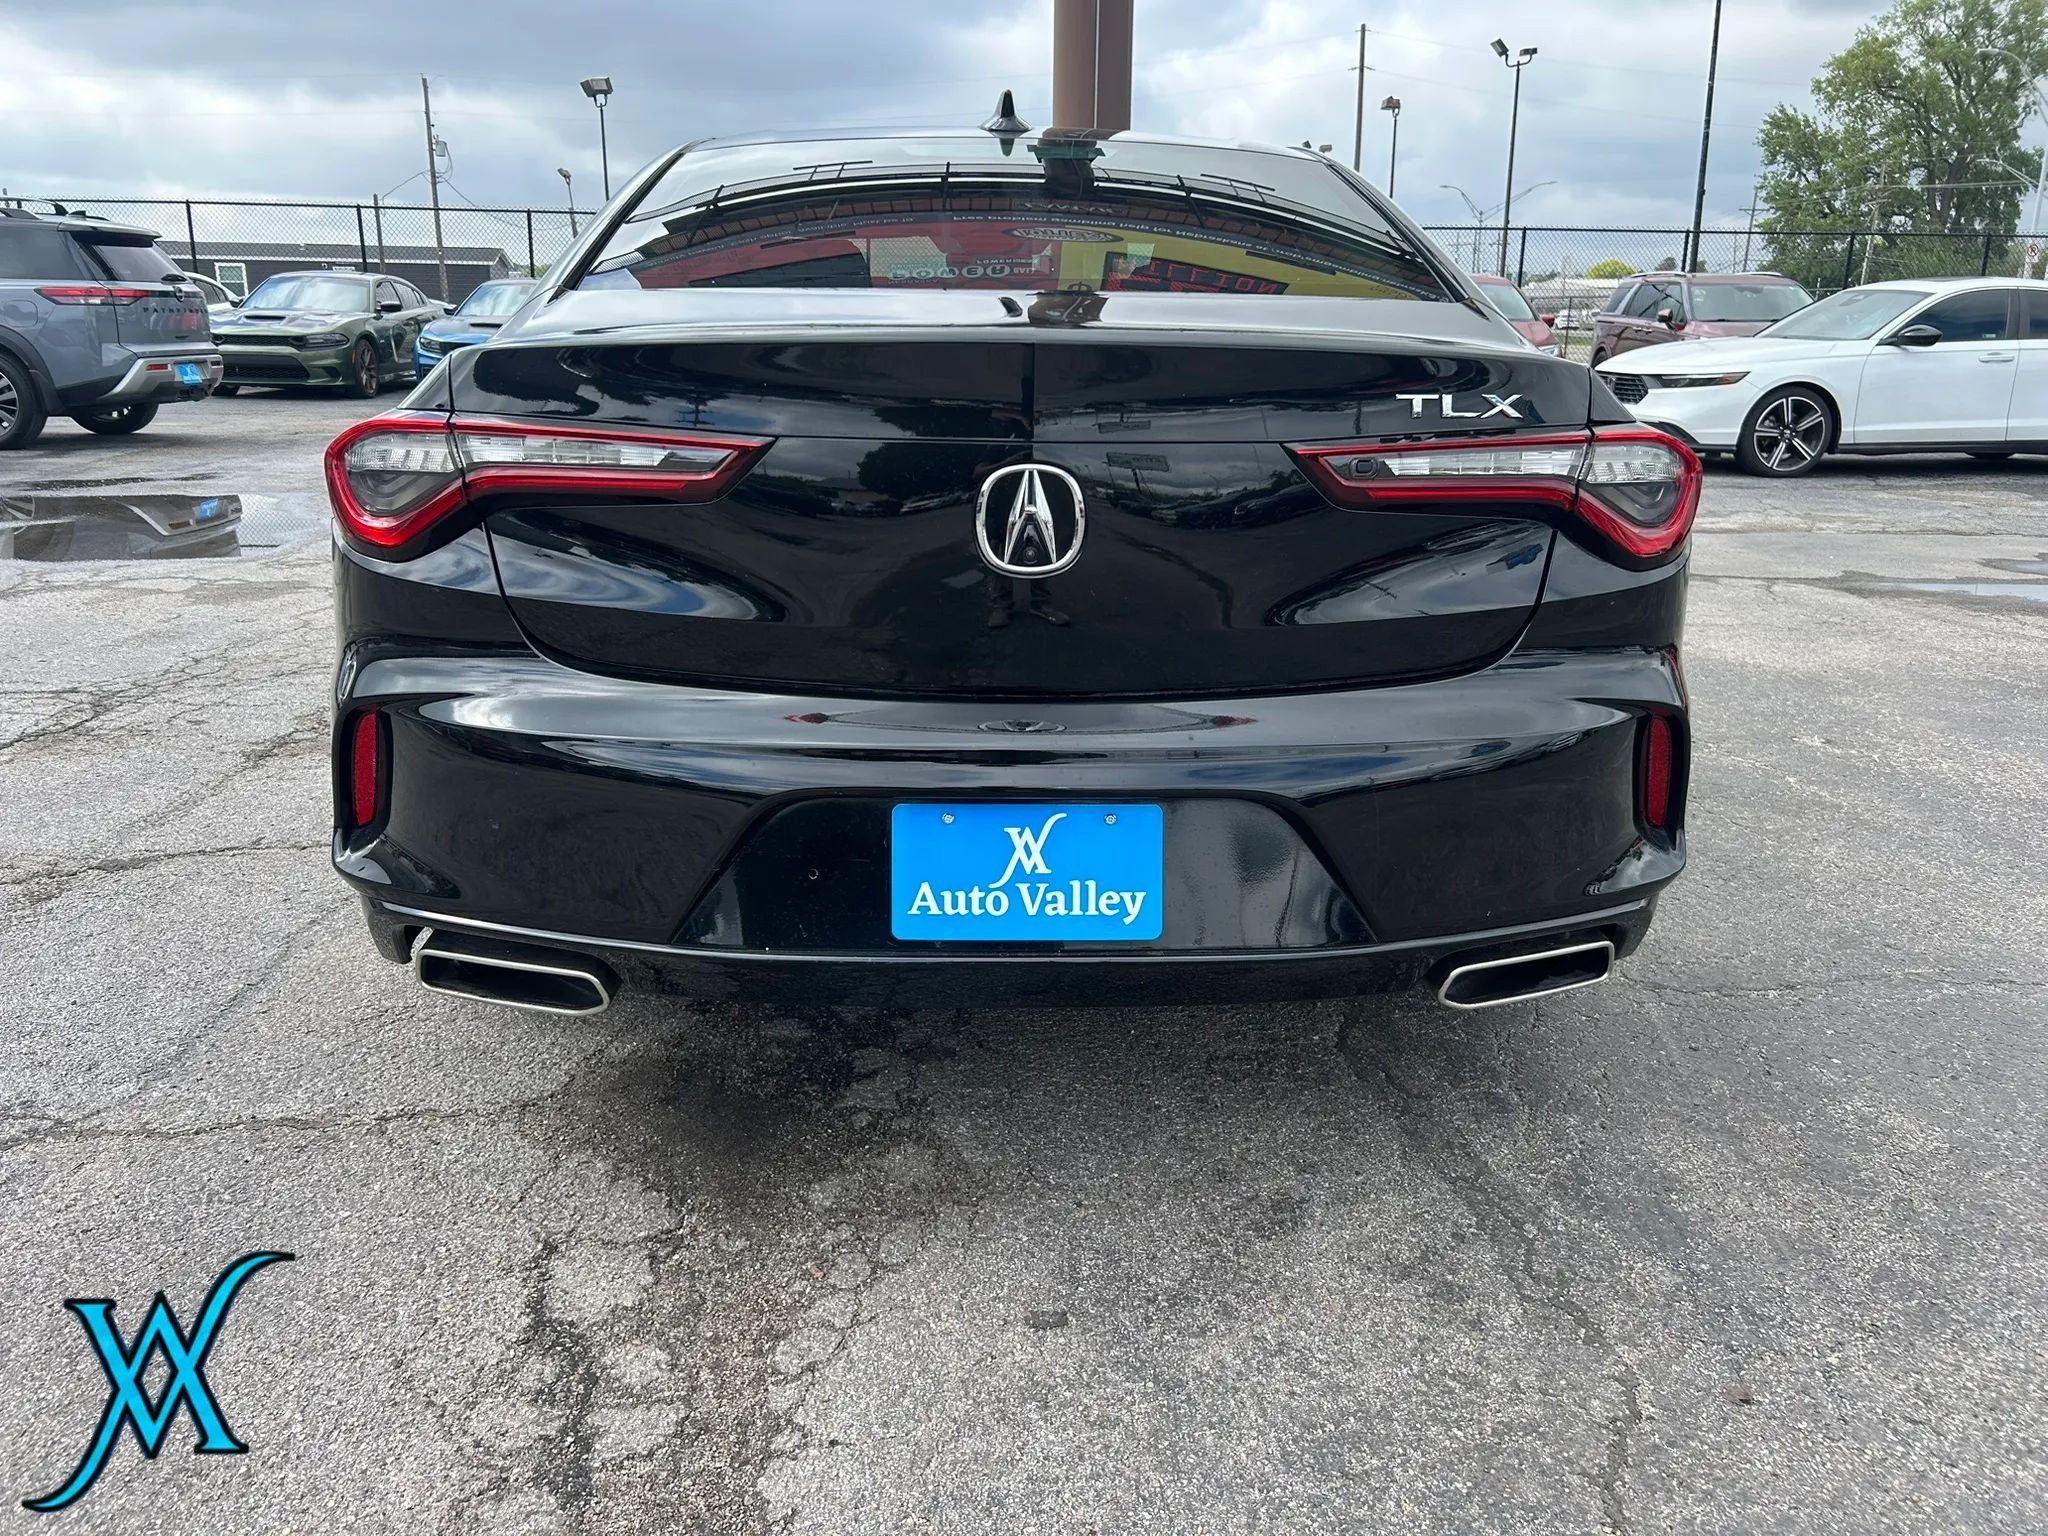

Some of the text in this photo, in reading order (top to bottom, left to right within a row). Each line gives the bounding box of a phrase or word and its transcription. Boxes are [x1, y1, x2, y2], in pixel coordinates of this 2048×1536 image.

[1395, 393, 1524, 419] TLX
[907, 879, 1147, 925] Auto Valley
